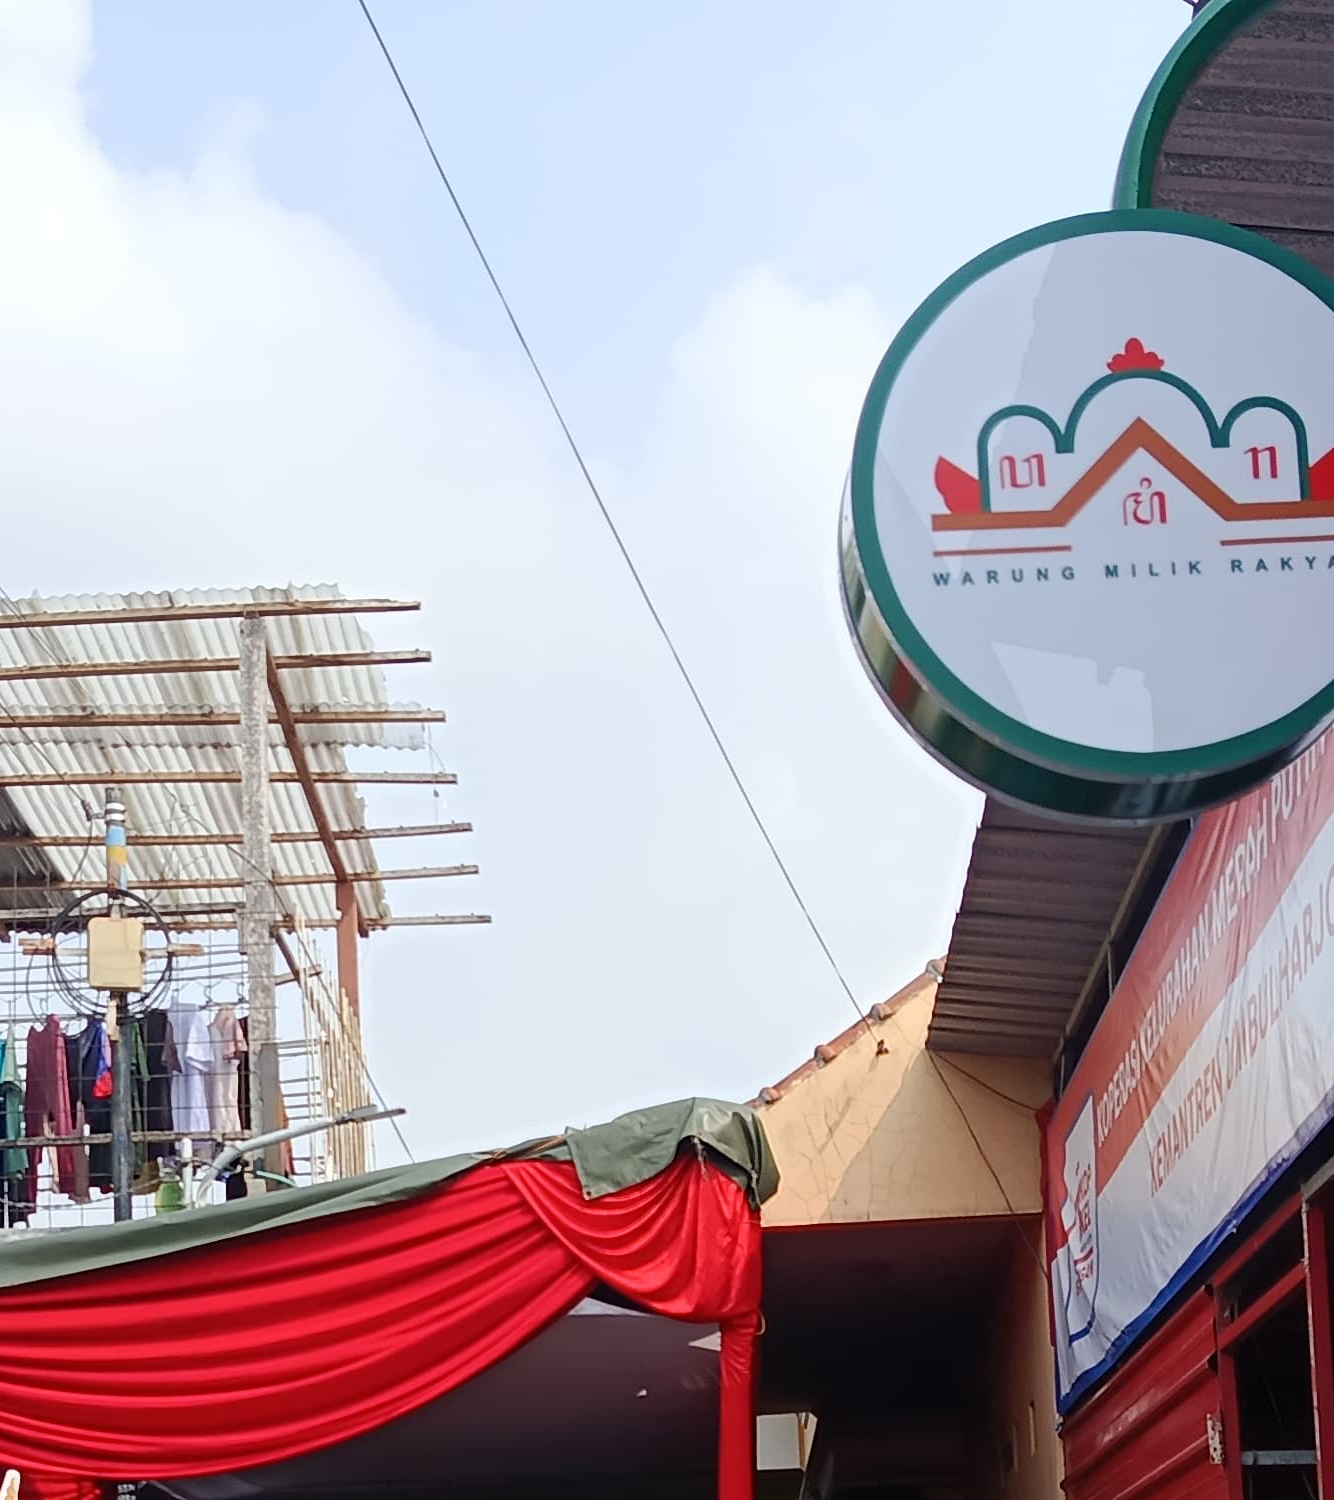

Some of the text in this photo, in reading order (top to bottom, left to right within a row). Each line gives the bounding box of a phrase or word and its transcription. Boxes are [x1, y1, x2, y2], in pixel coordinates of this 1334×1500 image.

[933, 566, 1075, 587] WARUNG
[1104, 560, 1203, 578] MILIK
[1097, 1036, 1140, 1148] KOPERASI
[1148, 1050, 1223, 1198] KEMANTREN
